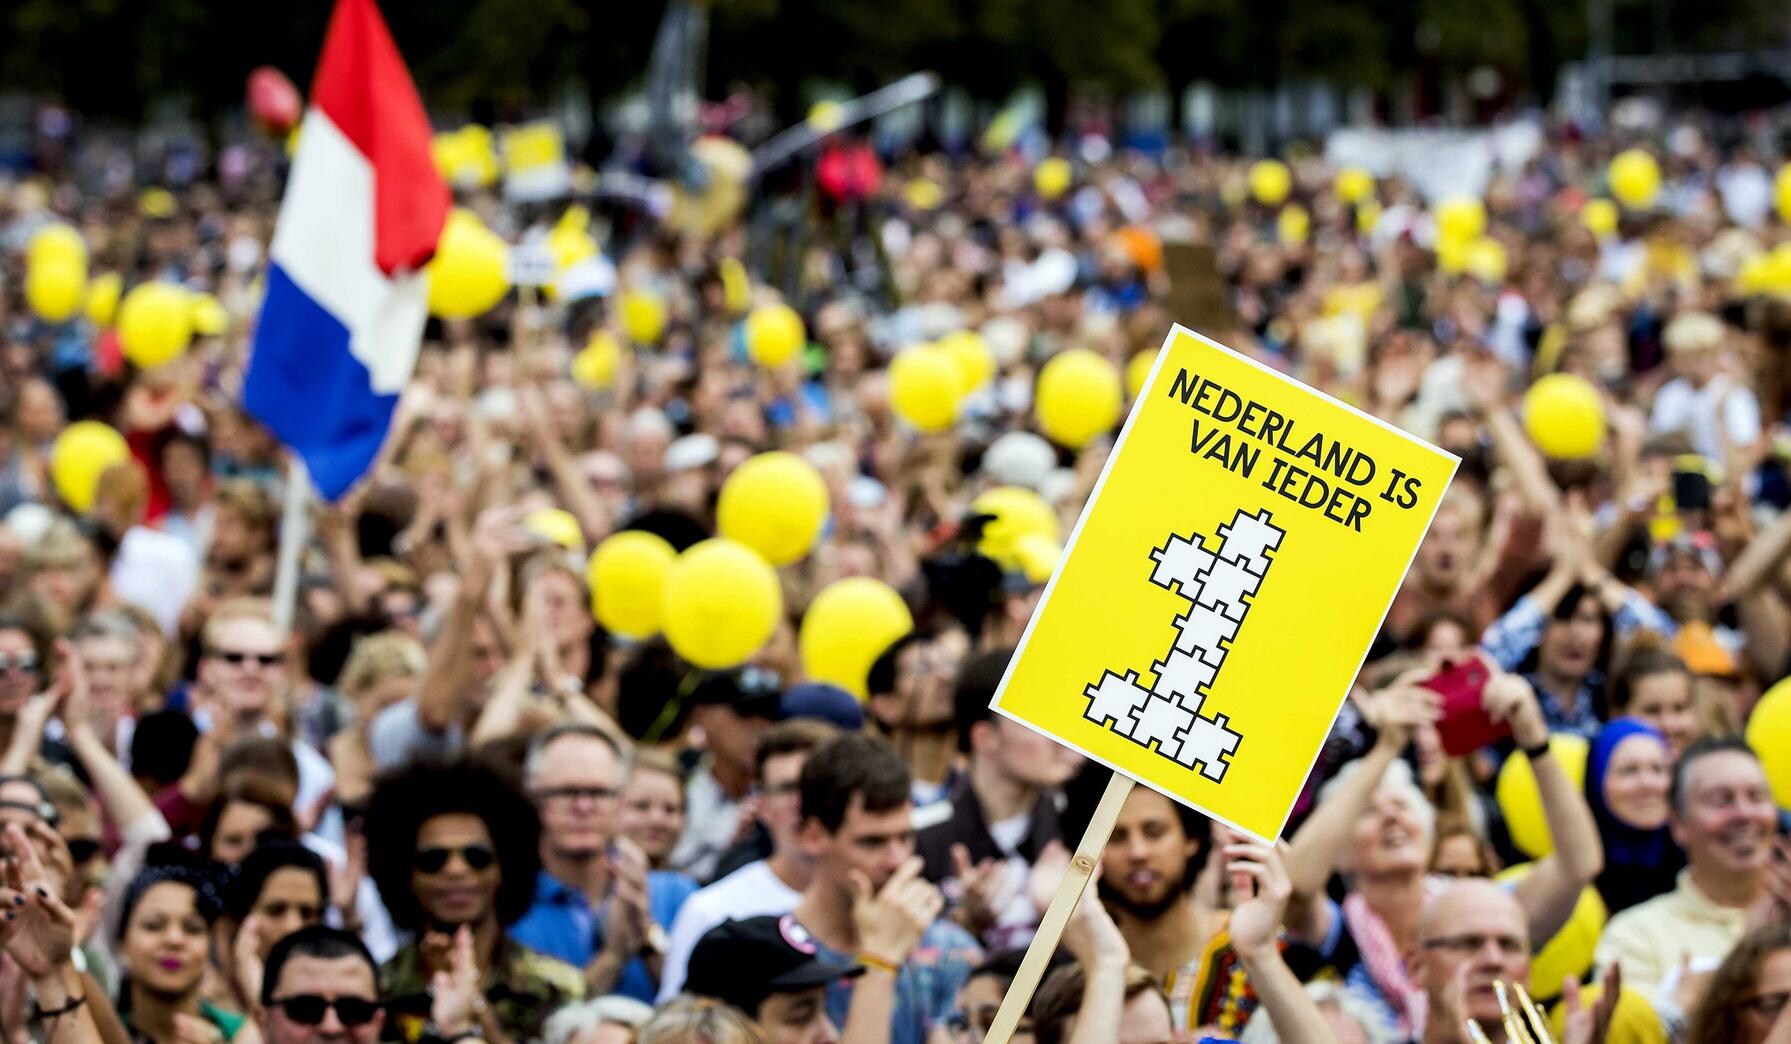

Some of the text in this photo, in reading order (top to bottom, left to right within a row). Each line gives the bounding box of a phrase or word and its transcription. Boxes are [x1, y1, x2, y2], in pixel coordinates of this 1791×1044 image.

[1168, 367, 1422, 510] NEDERLAND IS
[1190, 418, 1372, 533] VAN IEDER
[1083, 508, 1286, 784] 1
